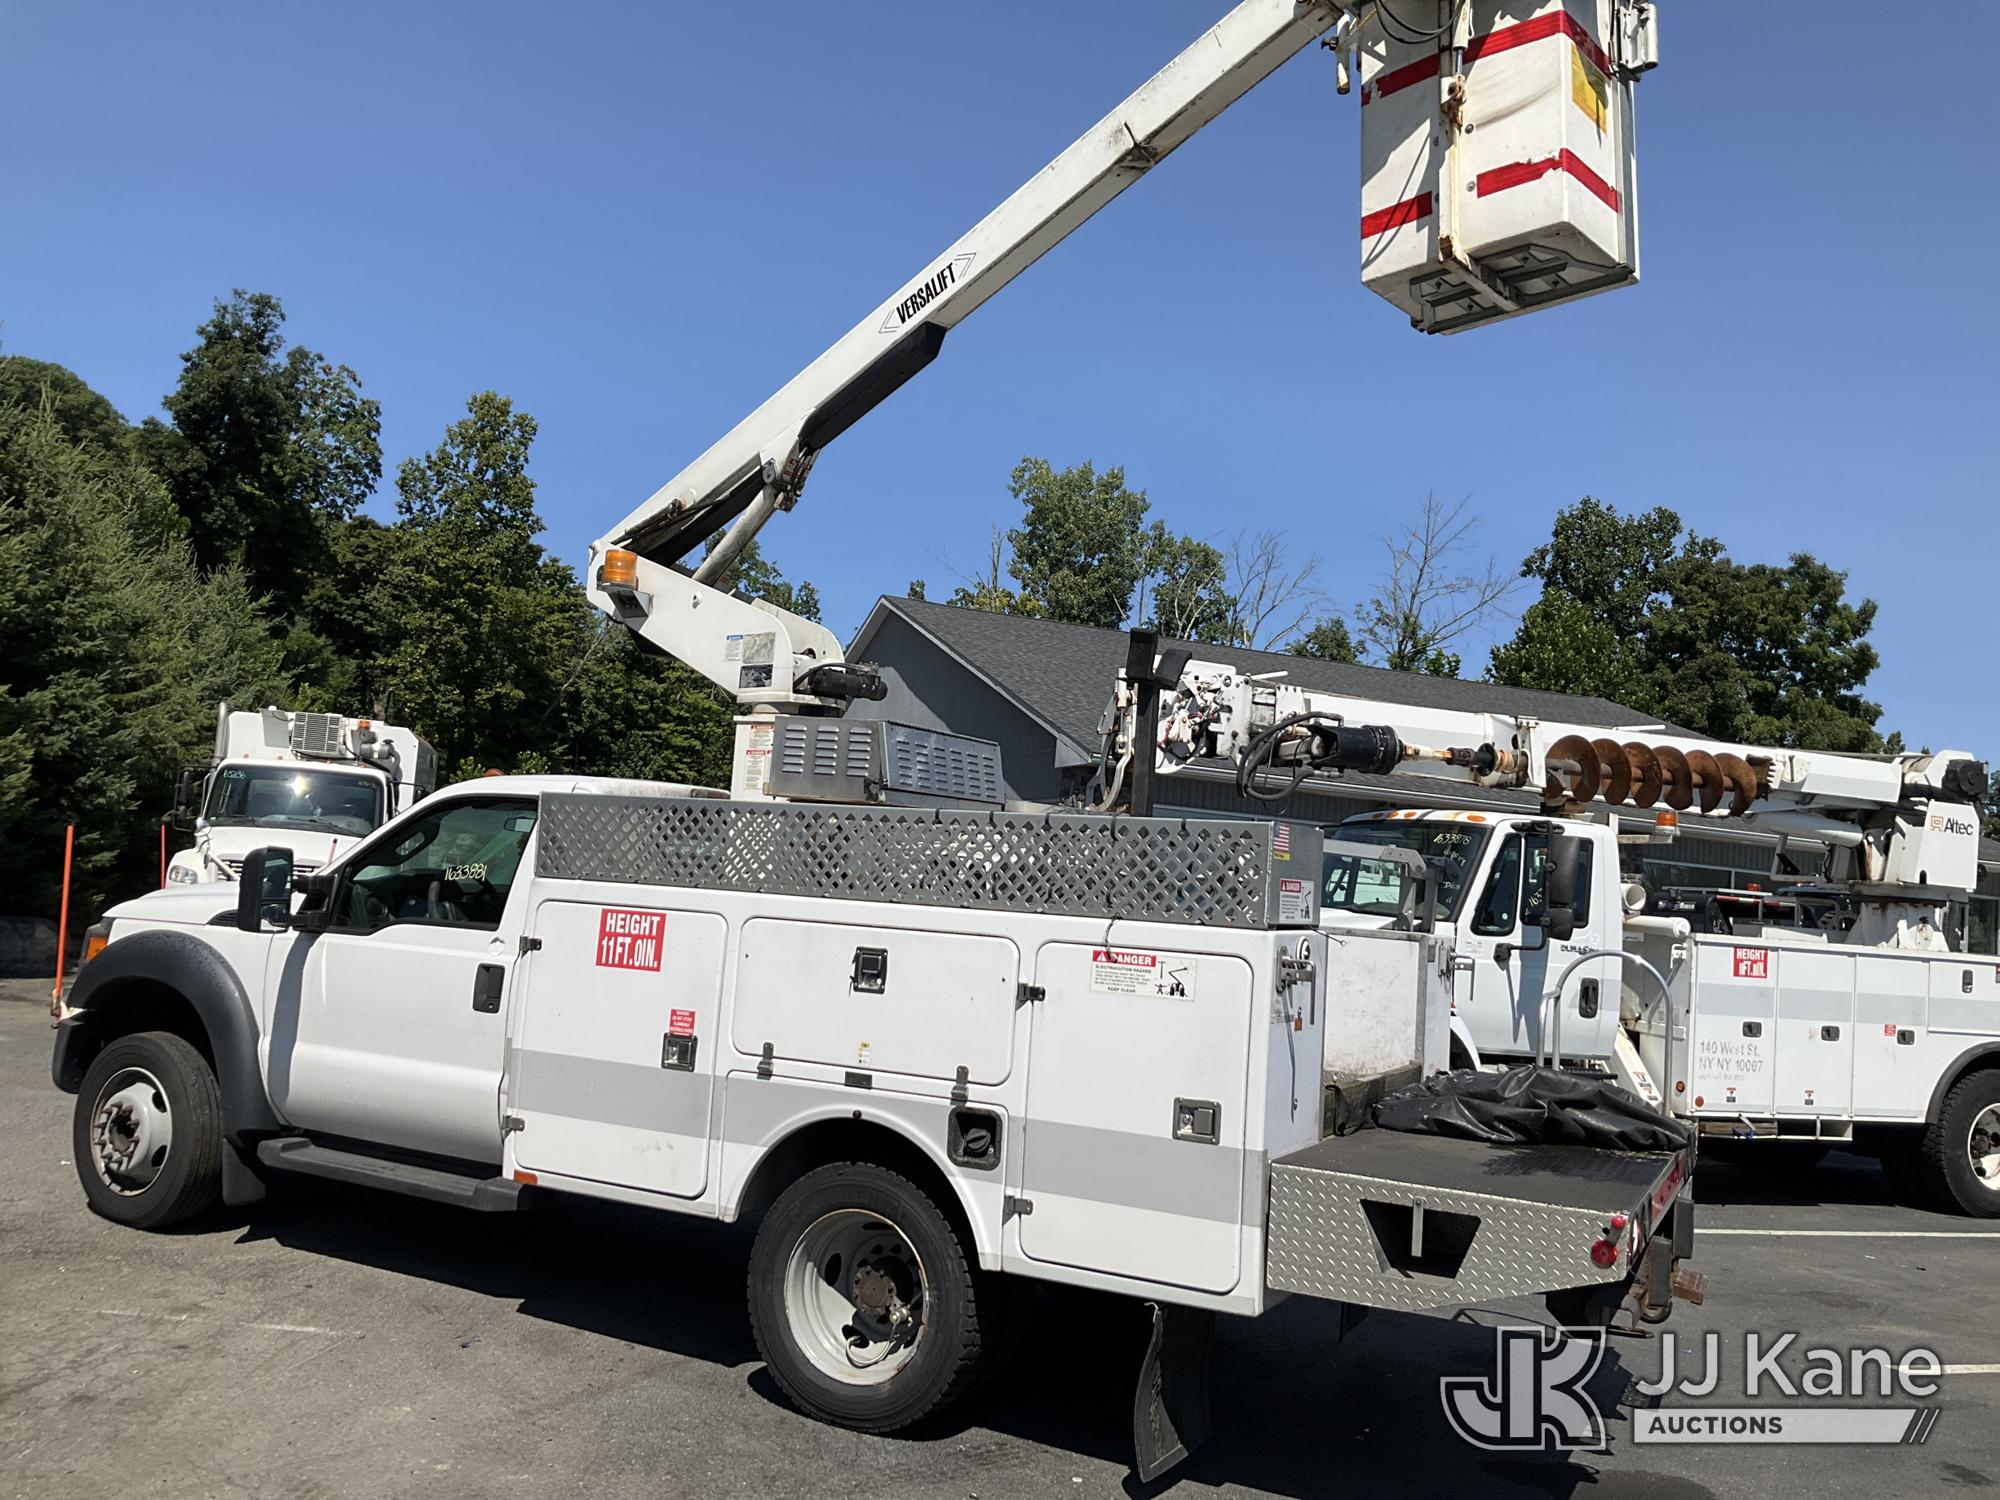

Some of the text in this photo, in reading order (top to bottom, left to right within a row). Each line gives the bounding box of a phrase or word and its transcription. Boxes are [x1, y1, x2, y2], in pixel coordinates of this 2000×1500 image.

[896, 262, 956, 325] VERSALIFT
[1944, 818, 1974, 836] Altec
[444, 863, 488, 882] 1633881
[606, 912, 660, 936] HEIGHT
[1736, 948, 1766, 961] HEIGHT
[1700, 1041, 1717, 1054] 140
[1699, 1057, 1714, 1070] NY
[1717, 1057, 1731, 1070] NY
